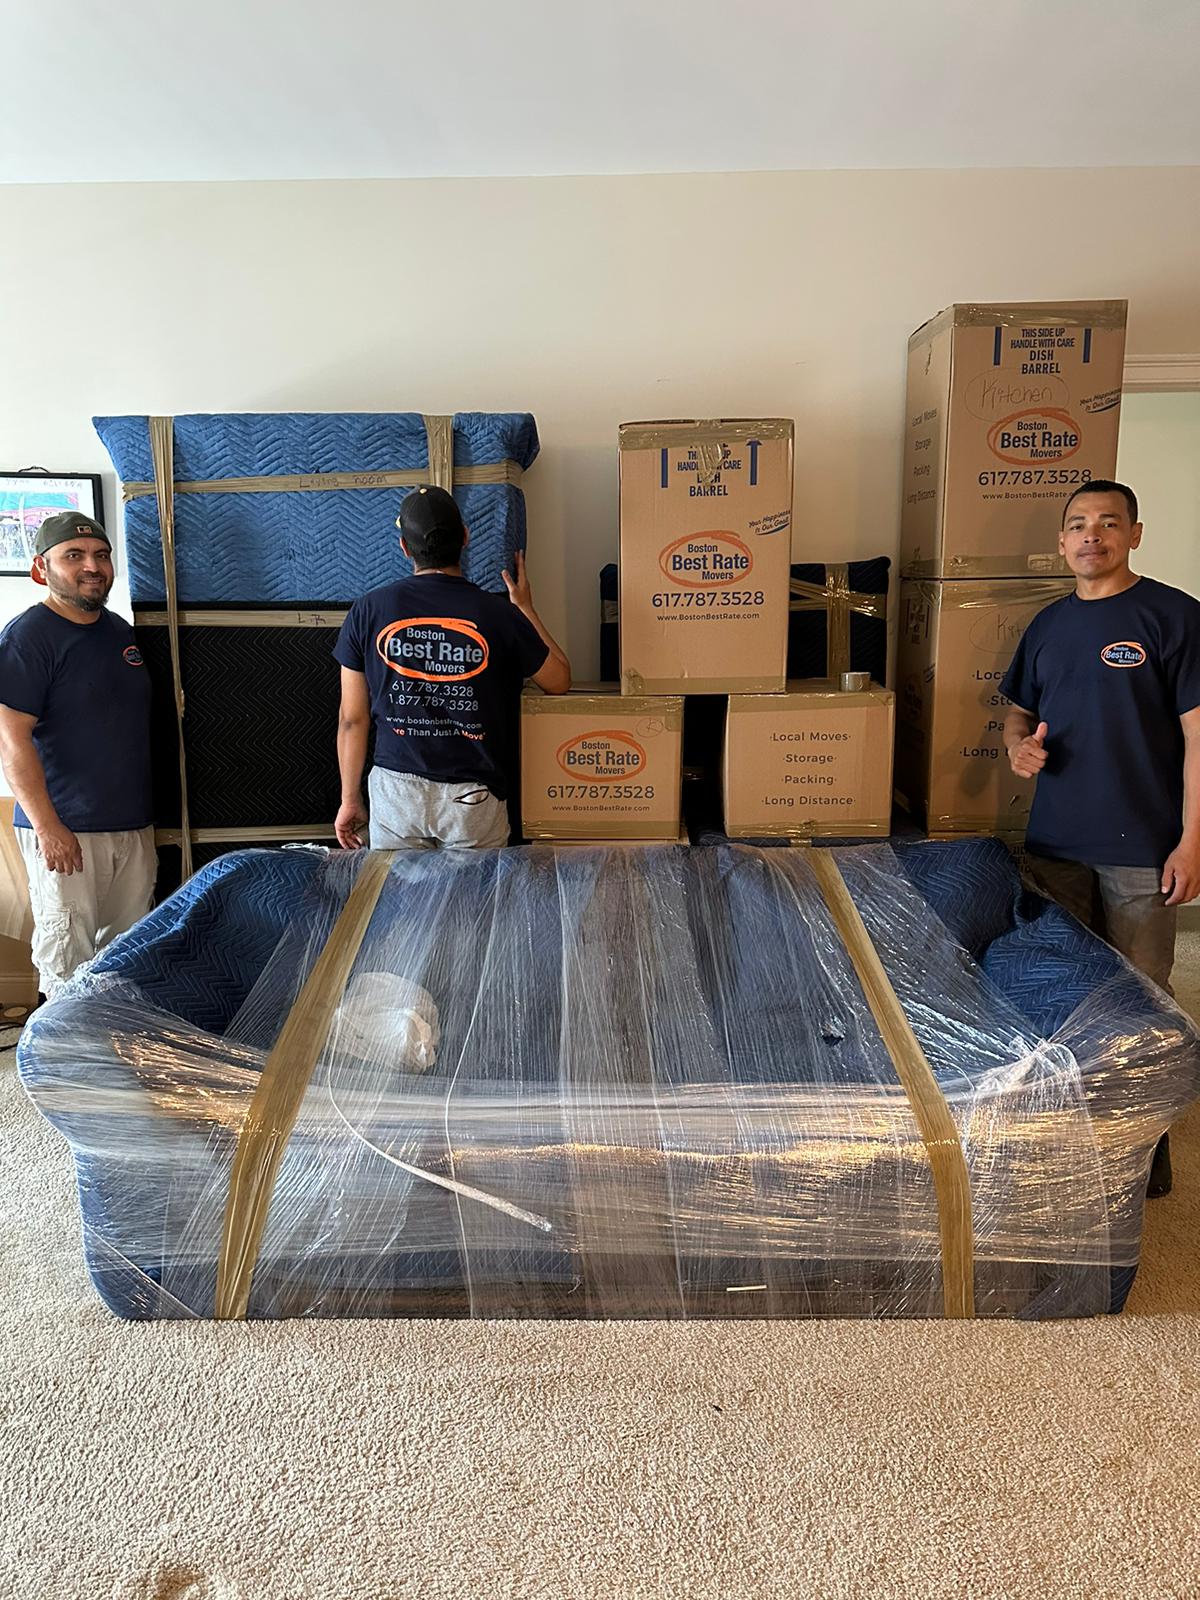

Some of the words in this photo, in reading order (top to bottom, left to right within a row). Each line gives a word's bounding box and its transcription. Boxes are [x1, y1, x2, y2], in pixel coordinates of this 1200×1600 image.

[1021, 328, 1037, 338] THIS
[1038, 328, 1054, 337] SIDE
[1055, 327, 1066, 336] UP
[1010, 339, 1037, 349] HANDLE
[1038, 338, 1056, 348] WITH
[1056, 337, 1075, 347] CARE
[1029, 350, 1054, 361] DISH
[1021, 362, 1061, 375] BARREL
[1017, 421, 1048, 431] Boston
[1001, 432, 1037, 448] Best
[1041, 431, 1078, 447] Rate
[1030, 448, 1062, 458] Movers
[723, 460, 742, 470] CARE
[978, 469, 1092, 486] 617.787.3528
[689, 485, 729, 497] BARREL
[687, 543, 718, 553] Boston
[672, 554, 708, 571] Best
[713, 553, 750, 570] Rate
[702, 570, 734, 581] Movers
[652, 591, 764, 608] 617.787.3528
[657, 612, 760, 622] www.BostonBestRate.com
[406, 627, 446, 641] Boston
[389, 637, 434, 660] Best
[439, 642, 483, 663] Rate
[1105, 651, 1123, 659] Best
[1124, 651, 1142, 660] Rate
[425, 660, 465, 674] Movers
[391, 680, 474, 697] 617.787.3528
[388, 693, 479, 711] 1.877.787.3528
[407, 727, 430, 737] Than
[432, 728, 451, 737] Just
[453, 728, 460, 736] A
[581, 741, 610, 750] Boston
[566, 750, 601, 765] Best
[605, 751, 640, 765] Rate
[595, 766, 625, 775] Movers
[547, 785, 655, 799] 617.787.3528
[552, 804, 650, 812] www.BostonBestRate.com
